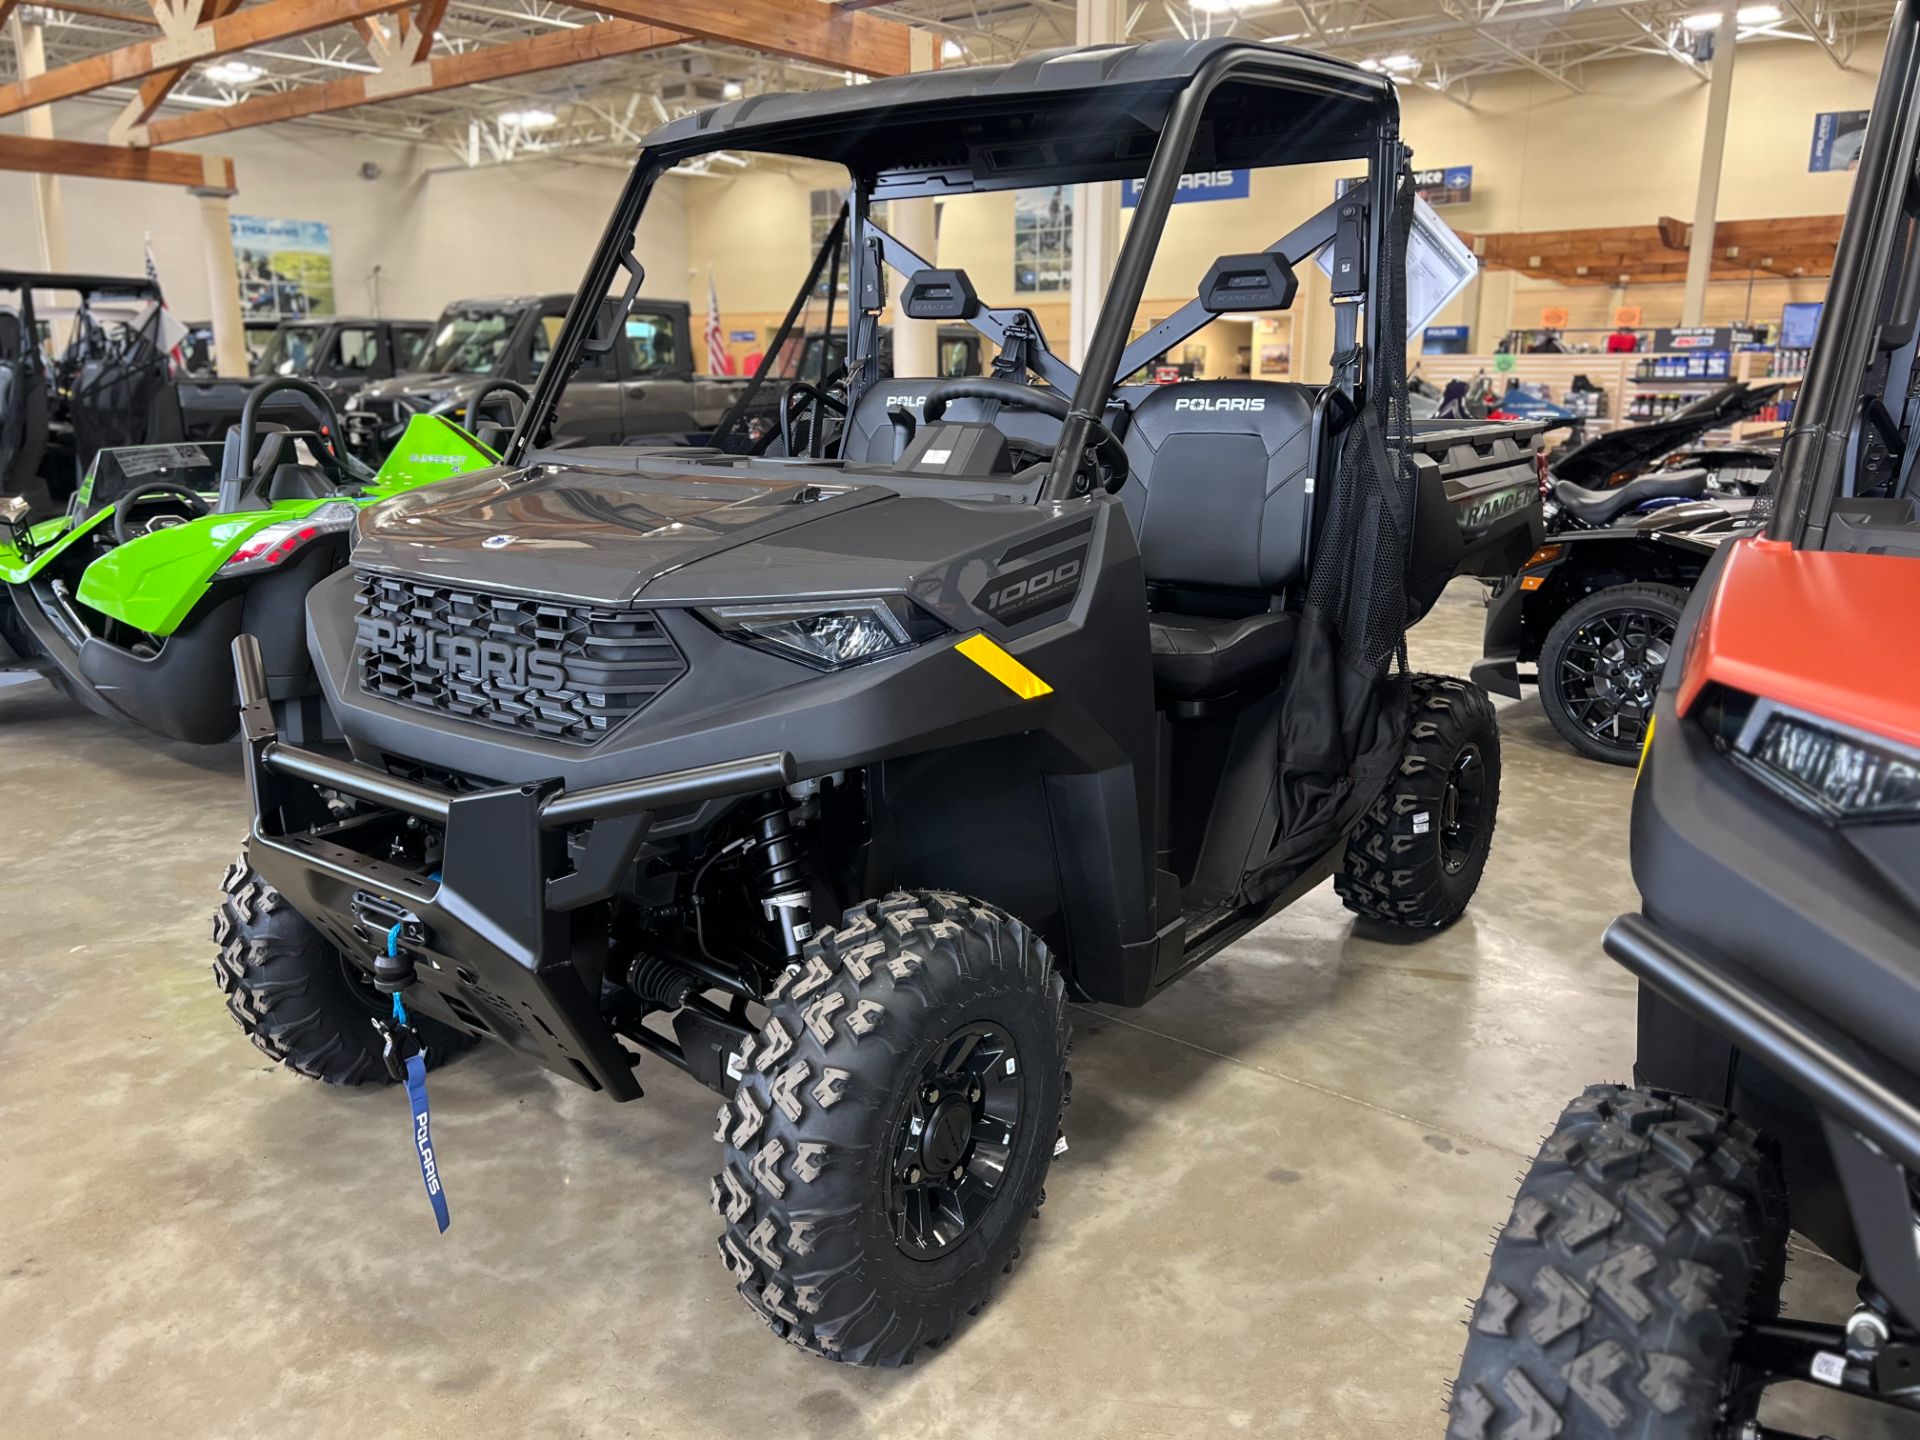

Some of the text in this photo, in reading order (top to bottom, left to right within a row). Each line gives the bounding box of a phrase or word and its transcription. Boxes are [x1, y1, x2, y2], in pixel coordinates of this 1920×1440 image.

[1131, 170, 1234, 194] PARIS
[1174, 398, 1266, 411] POLARIS
[1465, 489, 1534, 528] RANGER
[988, 559, 1081, 611] 1000
[370, 615, 567, 692] POLARIS
[416, 1111, 441, 1196] POLARIS
